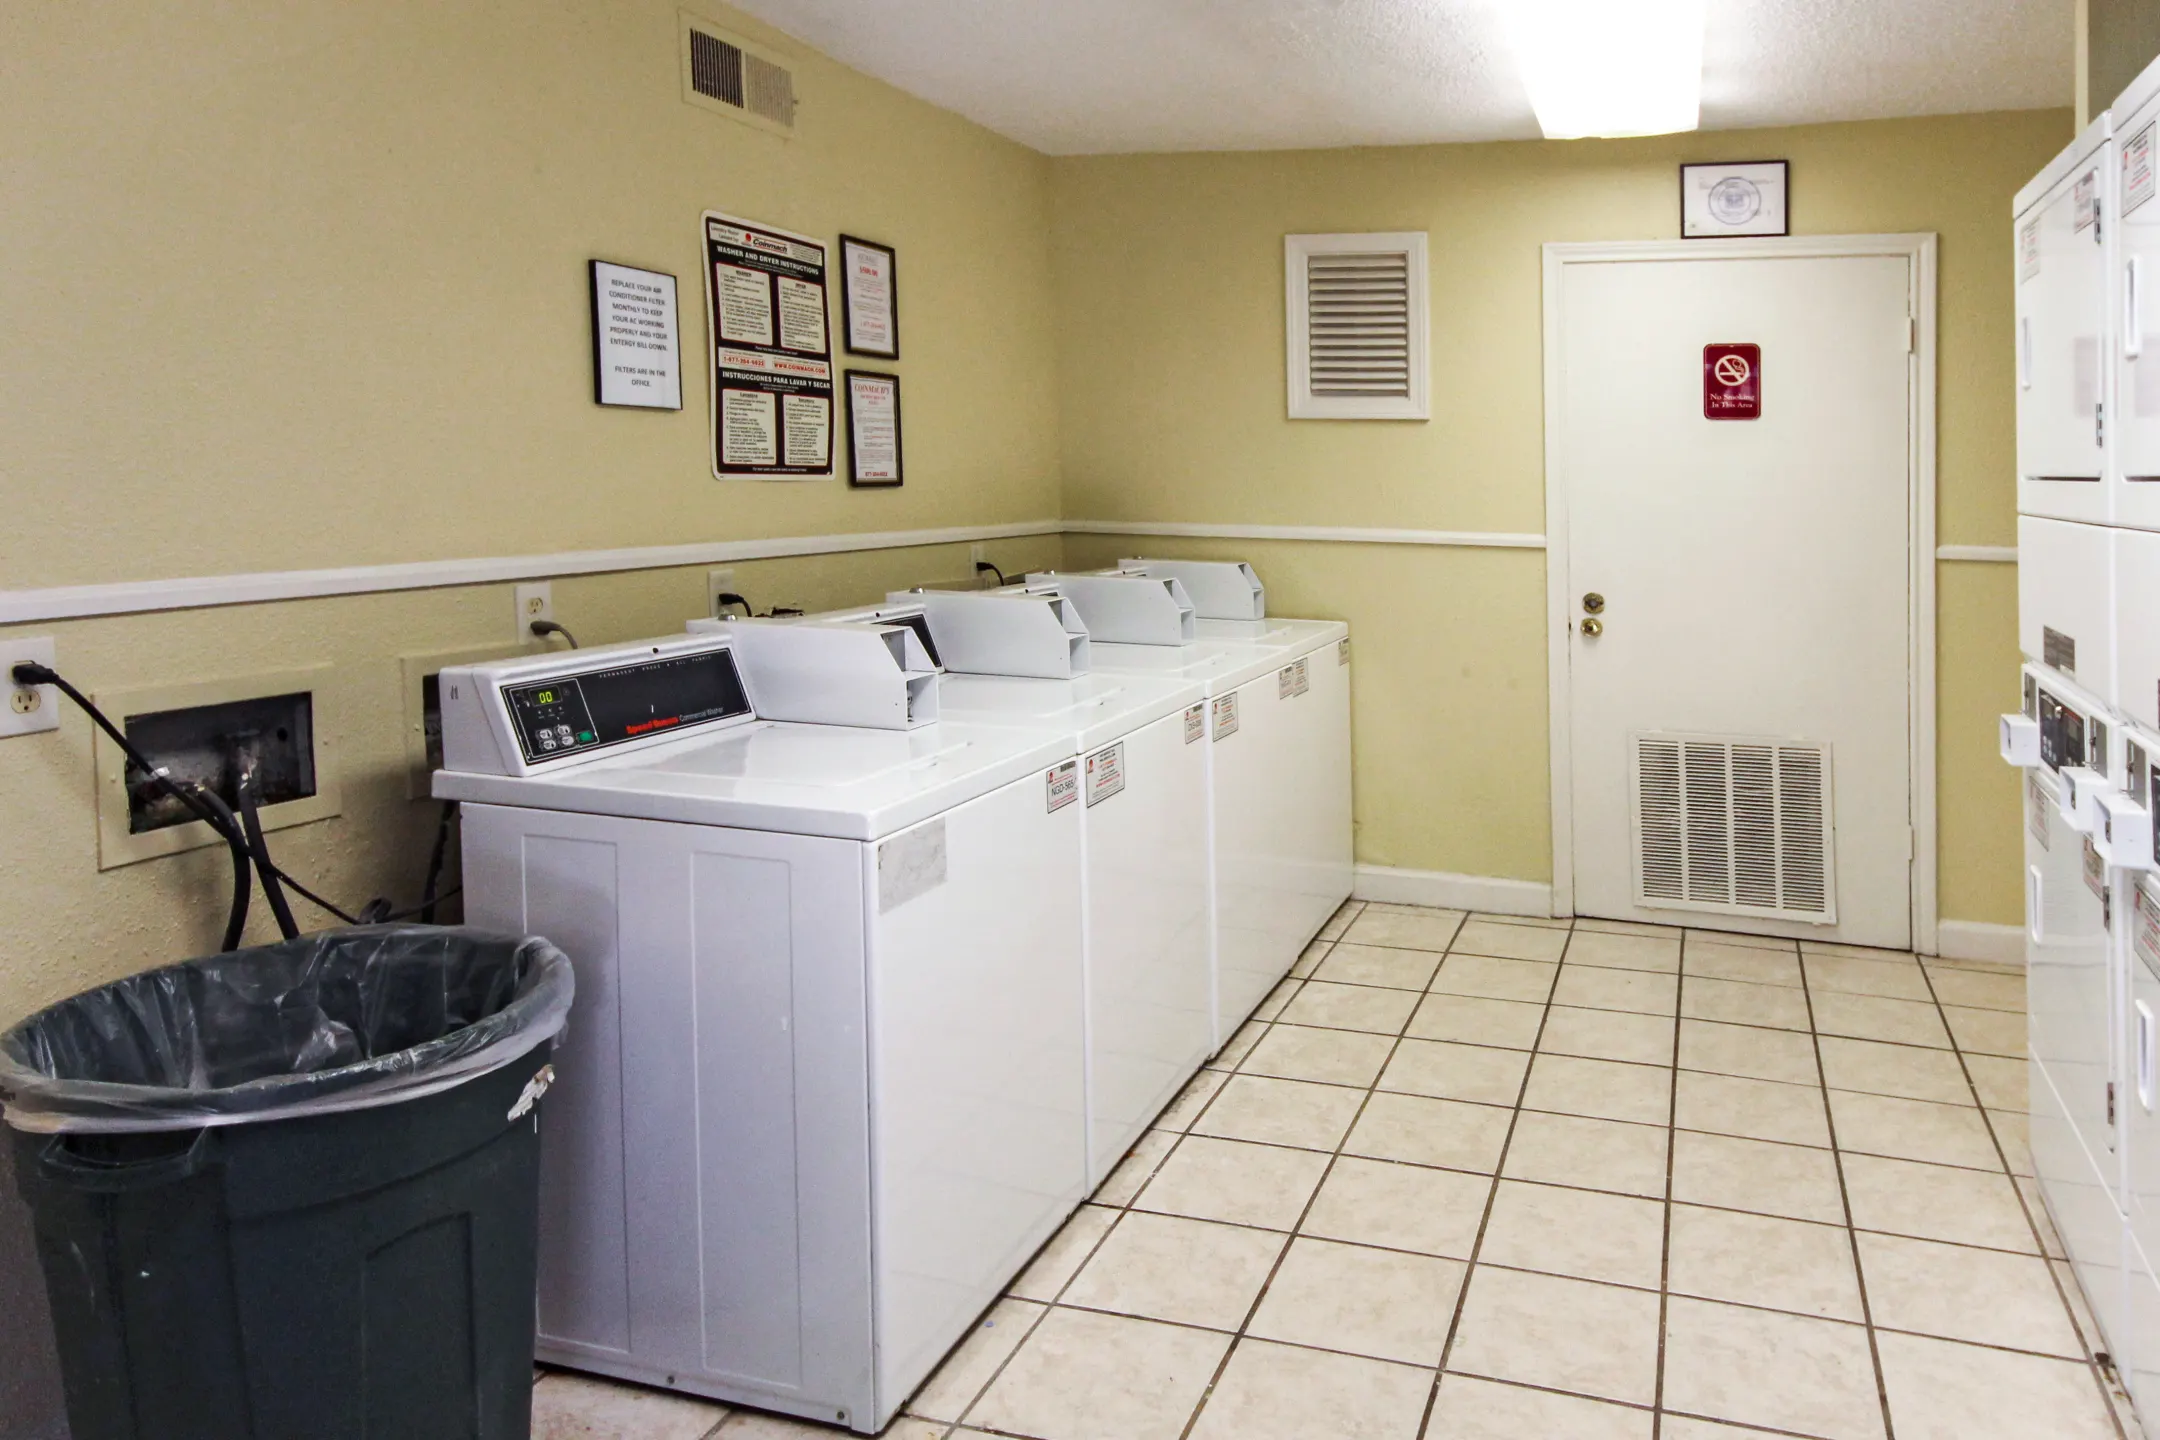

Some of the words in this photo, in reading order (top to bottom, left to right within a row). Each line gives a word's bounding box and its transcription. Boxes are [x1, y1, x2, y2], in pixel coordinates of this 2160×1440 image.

[753, 238, 788, 253] Coinmach
[716, 245, 744, 257] WASHER
[745, 251, 759, 261] AND
[760, 255, 780, 265] DRYER
[780, 259, 819, 275] INSTRUCTIONS
[611, 279, 635, 290] REPLACE
[637, 284, 652, 292] YOUR
[609, 290, 647, 303] CONDITIONER
[648, 298, 666, 306] FILTER
[612, 302, 640, 313] MONTHLY
[650, 309, 663, 317] KEEP
[612, 315, 628, 323] YOUR
[638, 320, 665, 329] WORKING
[609, 326, 638, 336] PROPERLY
[639, 330, 652, 338] AND
[652, 332, 668, 340] YOUR
[610, 338, 635, 348] ENTERGY
[636, 341, 647, 349] BILL
[615, 365, 637, 374] FILTERS
[722, 371, 772, 383] INSTRUCCIONES
[789, 378, 807, 387] LAVAR
[813, 381, 831, 389] SECAR
[1723, 393, 1755, 401] Smoking
[539, 691, 553, 703] 00
[680, 710, 706, 722] Commercial
